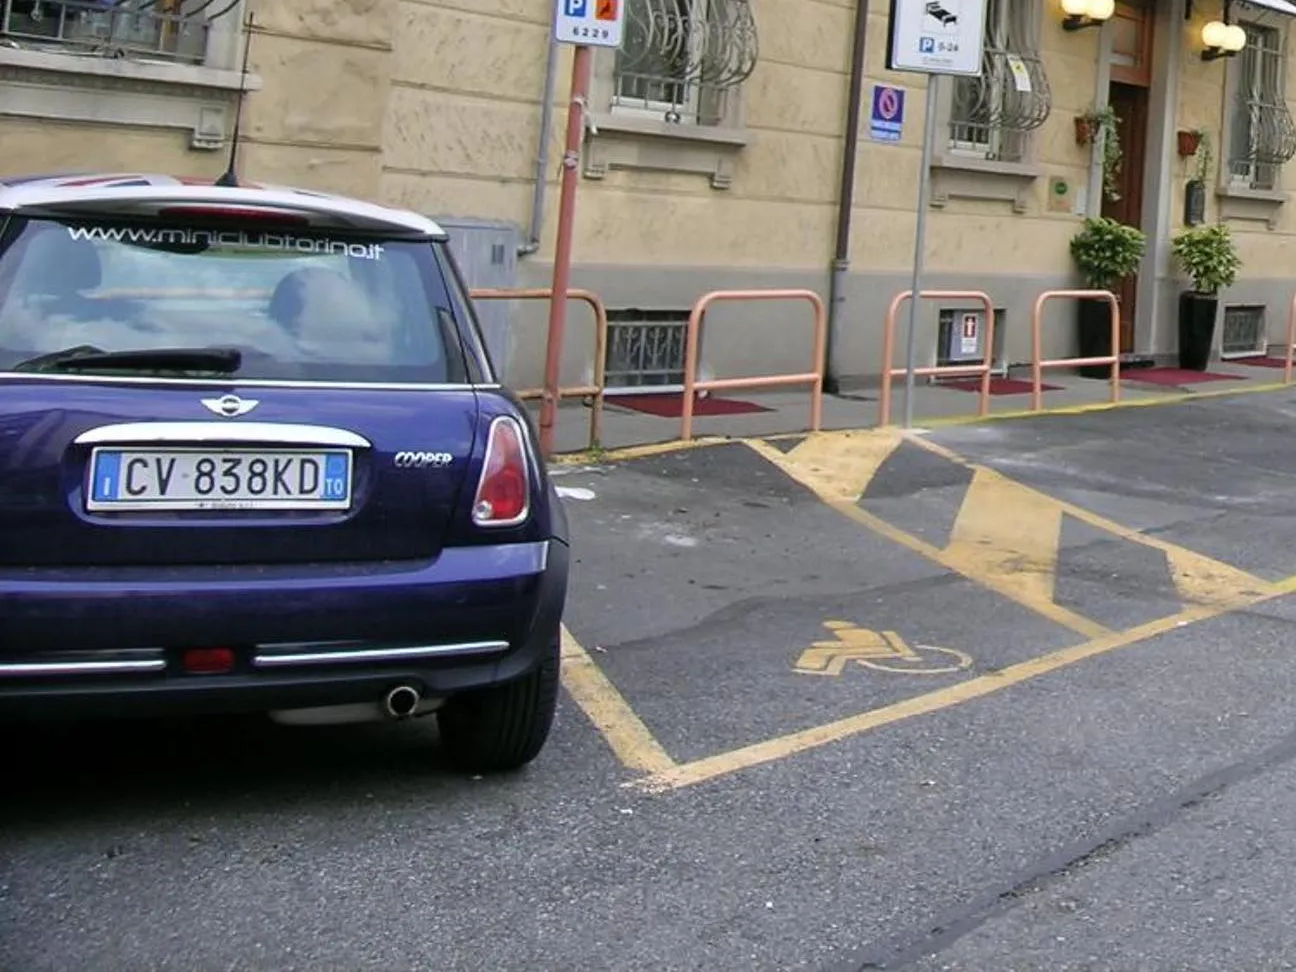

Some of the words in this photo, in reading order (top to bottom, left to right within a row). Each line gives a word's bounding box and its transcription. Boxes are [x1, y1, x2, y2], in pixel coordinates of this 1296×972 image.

[68, 226, 385, 260] www.miniclubtorino.it
[394, 450, 453, 468] COOPER
[125, 458, 176, 495] CV
[194, 458, 320, 495] 838KD
